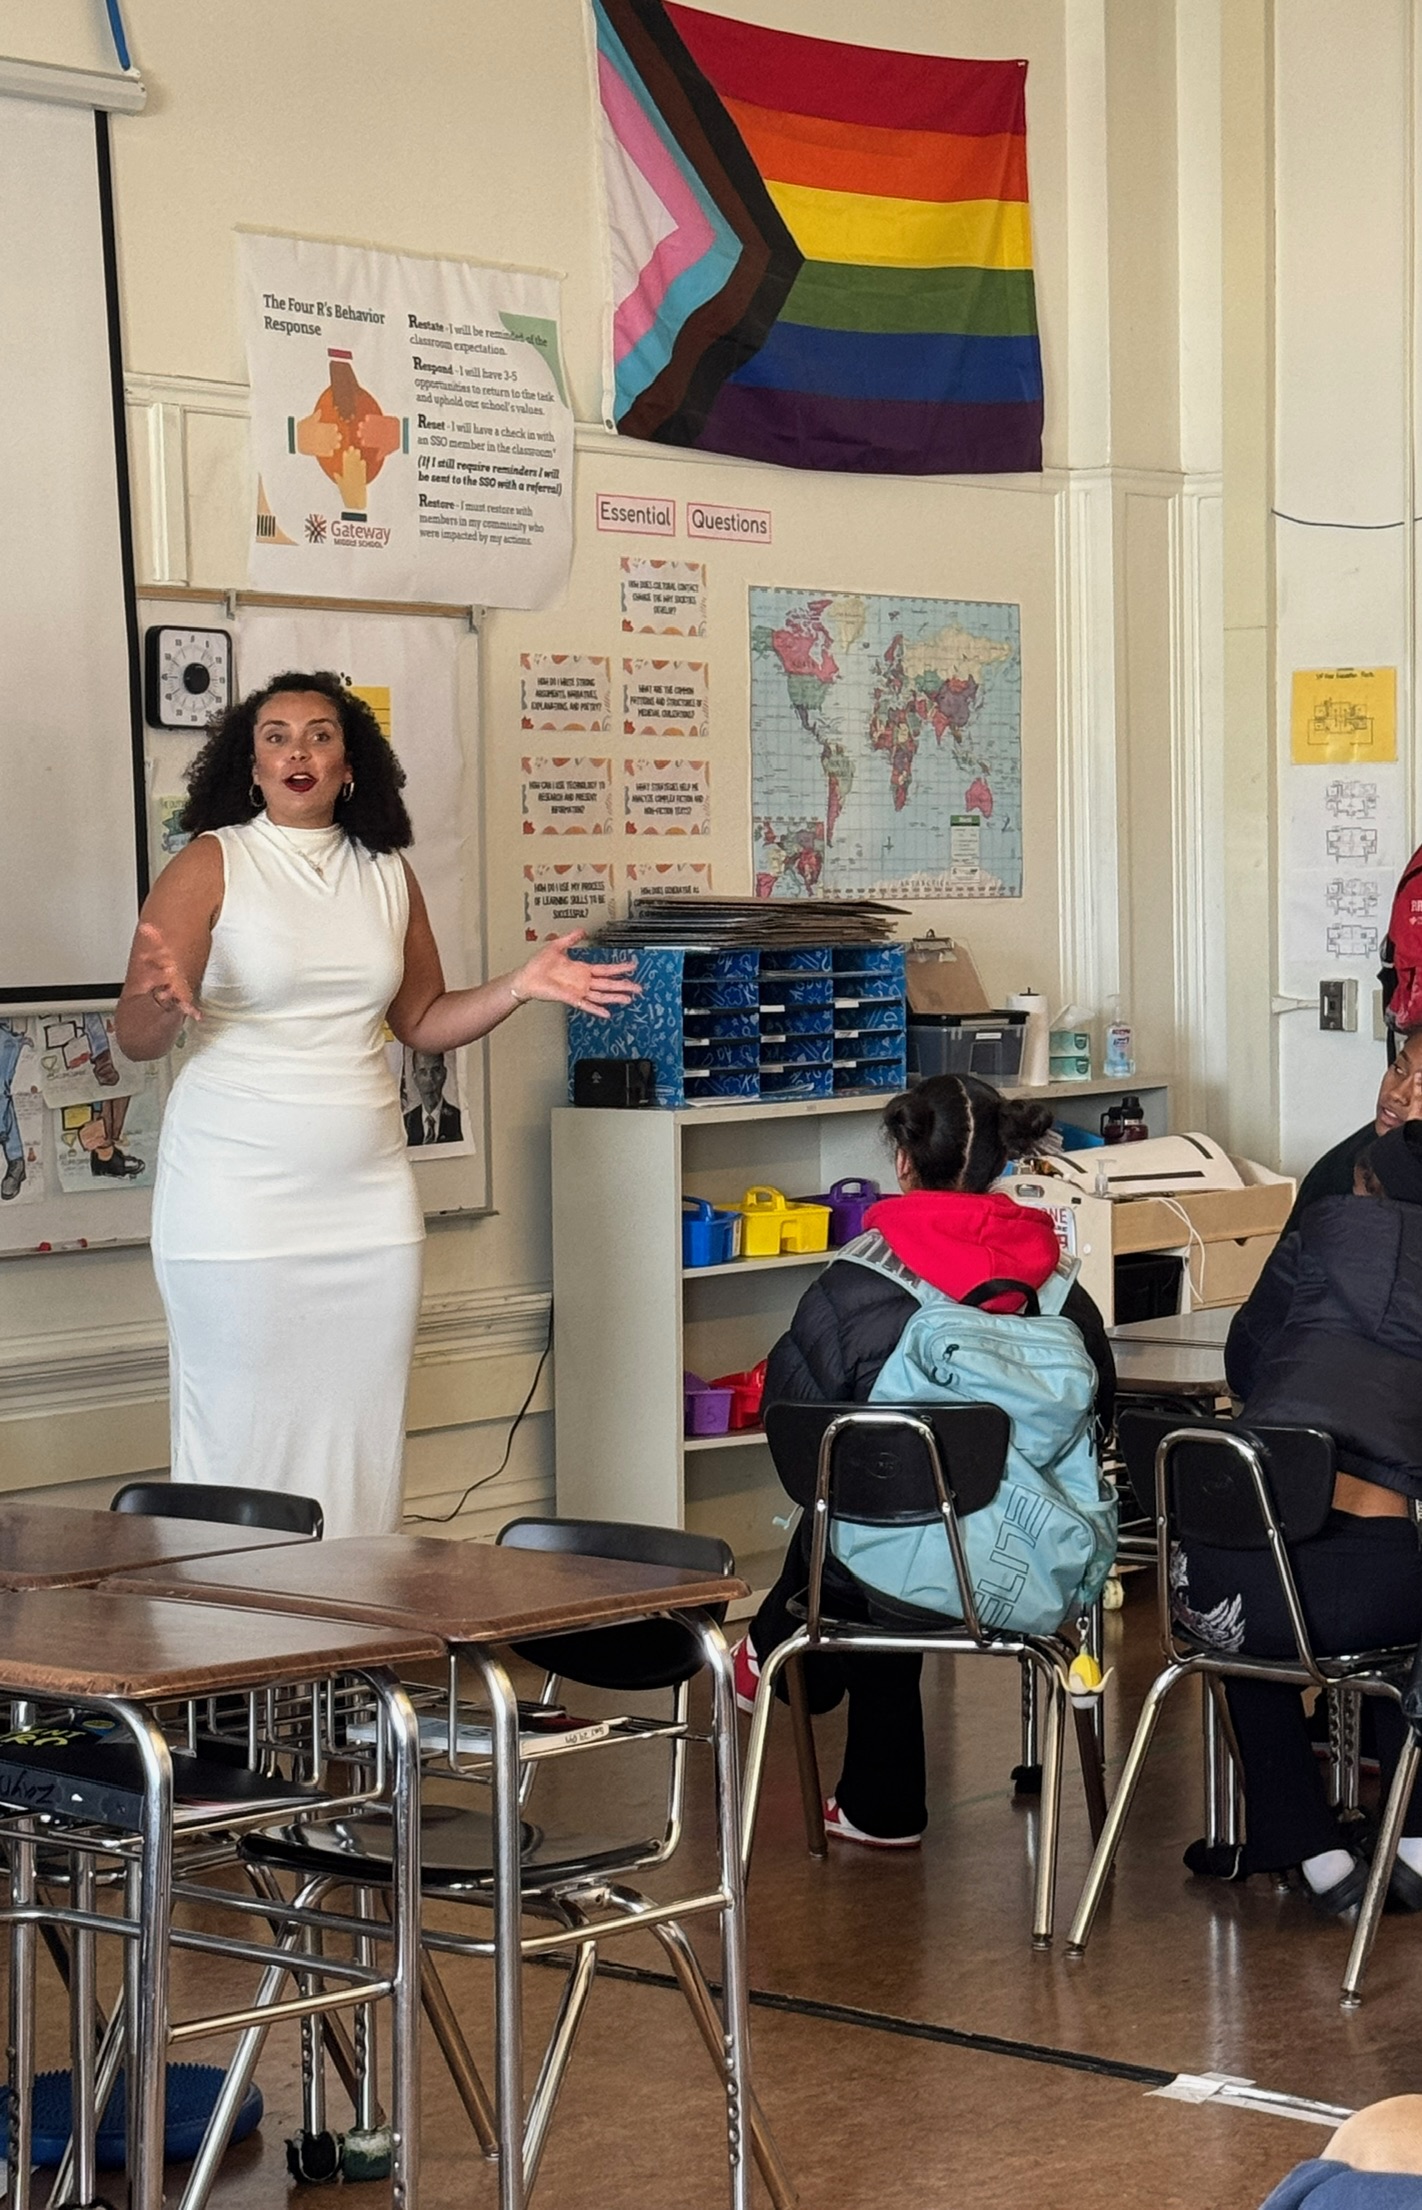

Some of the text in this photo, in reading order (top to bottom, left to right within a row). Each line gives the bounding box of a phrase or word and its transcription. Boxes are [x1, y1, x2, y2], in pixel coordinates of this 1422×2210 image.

[263, 294, 386, 324] The Four R's Behavior
[264, 316, 322, 336] Response
[408, 314, 444, 332] Restate
[454, 325, 472, 336] will
[472, 326, 484, 337] be
[534, 334, 548, 347] the
[410, 334, 453, 350] classroom
[412, 356, 453, 375] Respond
[465, 367, 481, 378] will
[482, 368, 502, 380] have
[504, 370, 518, 381] 3-5
[416, 392, 432, 403] and
[434, 395, 463, 407] uphold
[464, 399, 479, 409] our
[472, 384, 482, 394] to
[482, 385, 510, 397] return
[511, 388, 521, 398] to
[522, 388, 536, 400] the
[418, 413, 445, 431] Reset
[456, 422, 472, 433] will
[473, 423, 493, 436] have
[501, 427, 526, 439] check
[527, 430, 536, 440] in
[536, 431, 555, 442] with
[418, 436, 429, 445] an
[430, 436, 448, 447] SSO
[449, 440, 485, 451] member
[486, 442, 496, 452] in
[497, 444, 511, 454] the
[437, 458, 455, 469] still
[457, 461, 490, 473] require
[492, 464, 537, 478] reminders
[544, 468, 559, 479] will
[418, 471, 430, 482] be
[431, 474, 450, 483] sent
[452, 475, 462, 485] to
[463, 476, 478, 486] the
[479, 476, 496, 488] SSO
[498, 479, 517, 490] with
[418, 494, 533, 517] Restore must restore with
[420, 514, 545, 534] members in my community who
[600, 501, 768, 534] Essential Questions
[330, 520, 391, 546] Gateway
[420, 529, 440, 538] were
[441, 529, 478, 542] impacted
[479, 532, 488, 544] by
[490, 535, 502, 545] my
[534, 880, 605, 893] HOW DO USE MY PROCESS
[534, 894, 606, 906] OF LEARNING SKILLS TO BE
